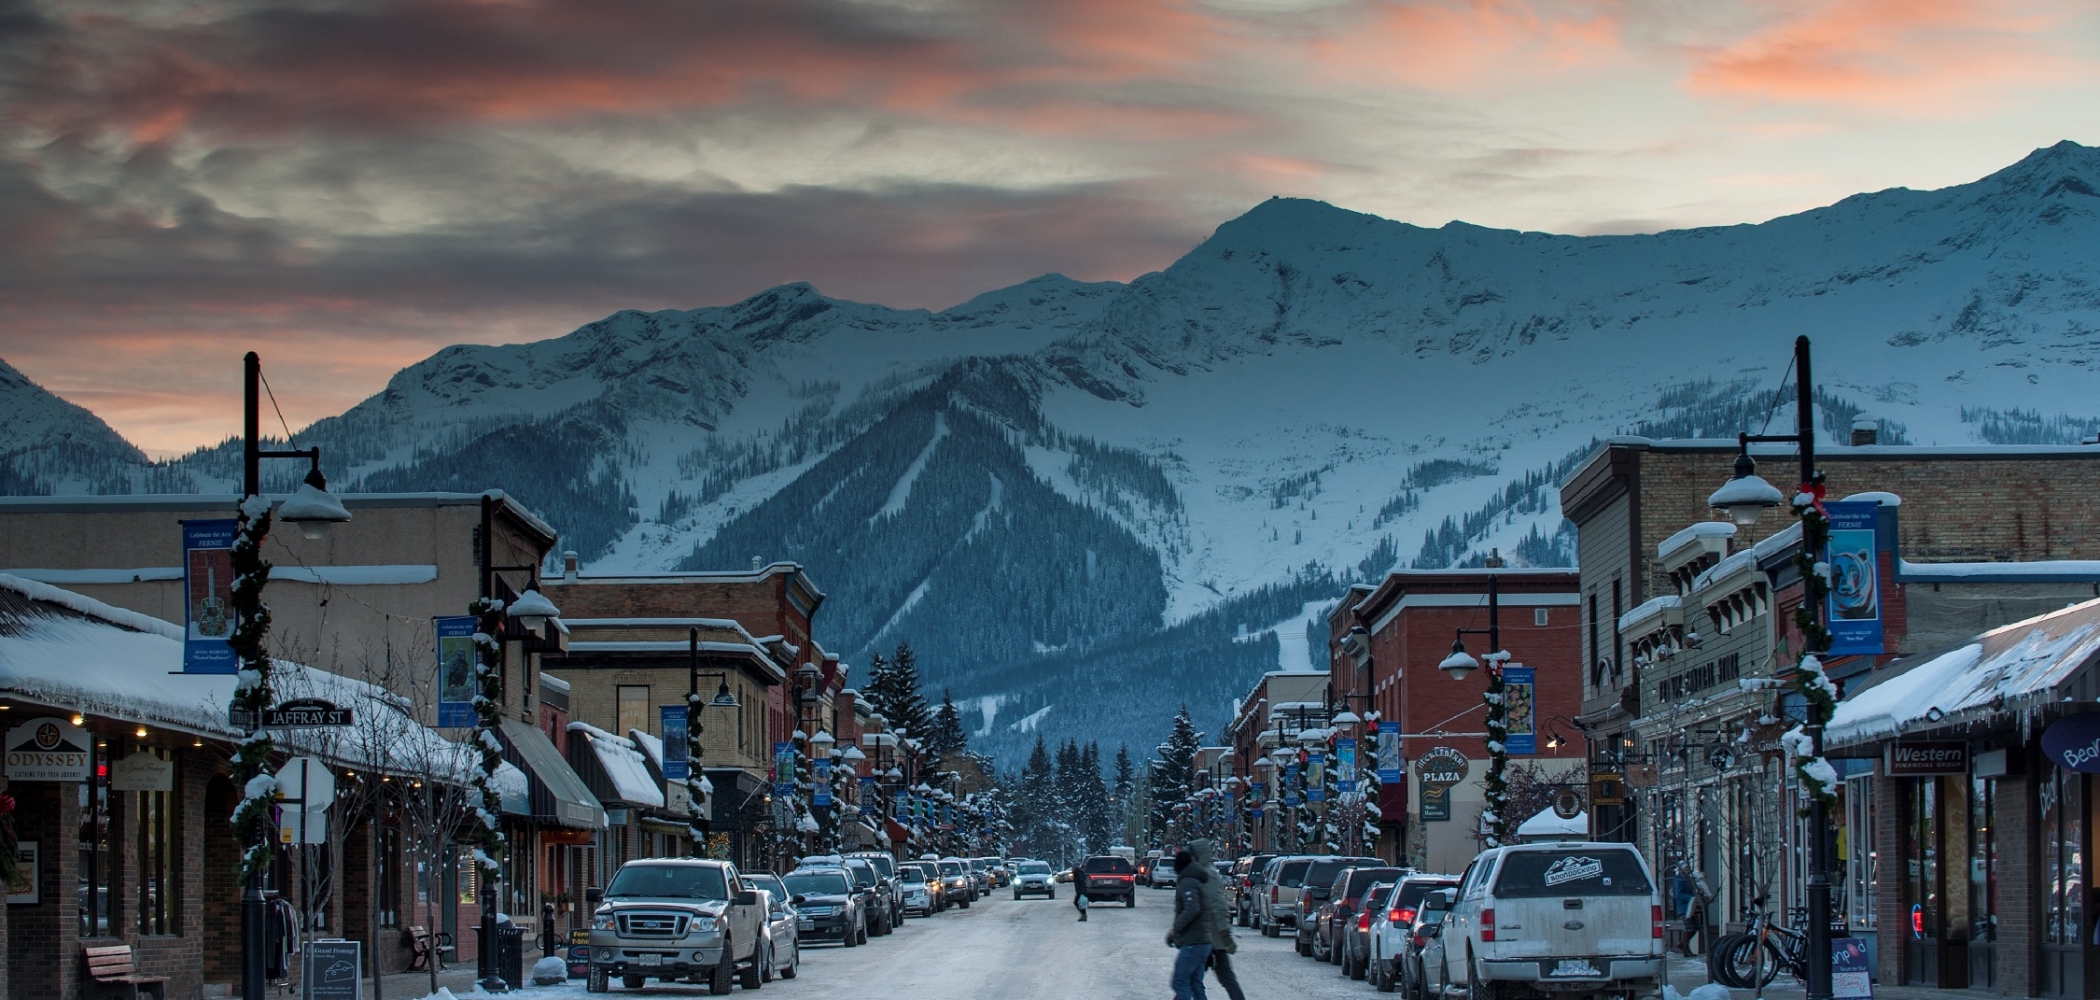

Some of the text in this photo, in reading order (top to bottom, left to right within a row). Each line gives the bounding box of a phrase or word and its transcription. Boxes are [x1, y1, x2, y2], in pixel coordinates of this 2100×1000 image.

[271, 711, 344, 724] JAFFRAY ST
[7, 753, 88, 767] ODYSSEY
[1417, 748, 1465, 769] HUCKLEBERRY
[1895, 747, 1962, 762] Western
[1423, 772, 1460, 782] PLAZA
[1550, 865, 1597, 881] BOONDOCKING
[333, 947, 356, 955] Fromage
